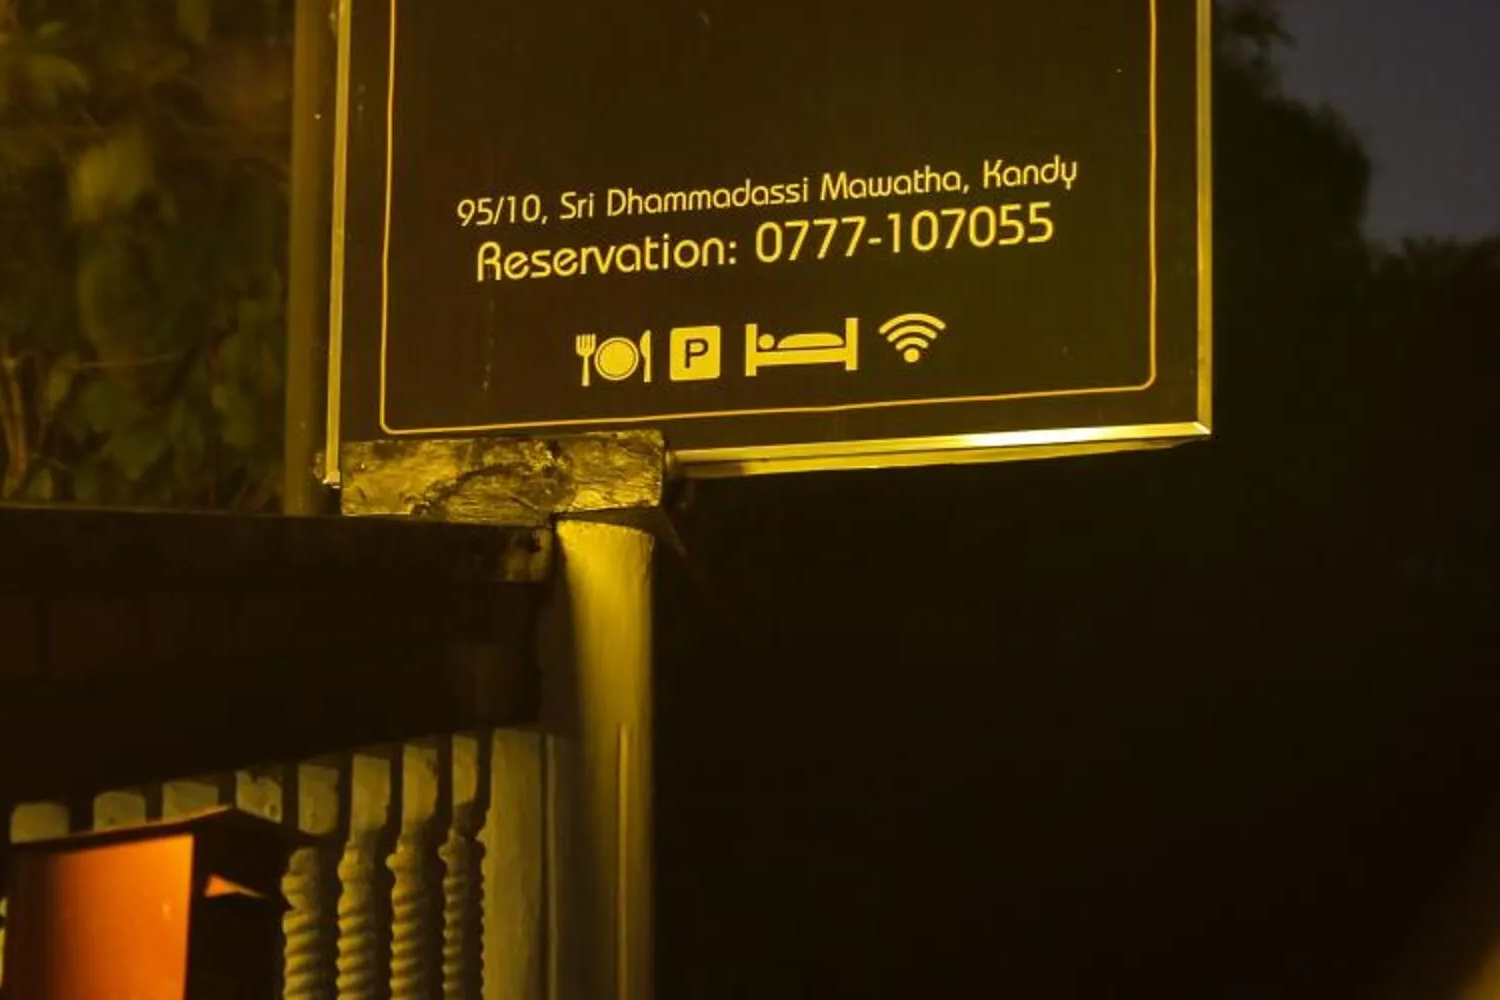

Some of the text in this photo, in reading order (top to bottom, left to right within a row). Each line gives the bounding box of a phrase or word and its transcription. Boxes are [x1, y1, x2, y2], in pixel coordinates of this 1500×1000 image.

[456, 154, 1078, 228] 95/10, Sri Dhammadassi Mawatha, Kandy
[477, 201, 1054, 282] Reservation: 0777-107055
[684, 336, 709, 368] P
